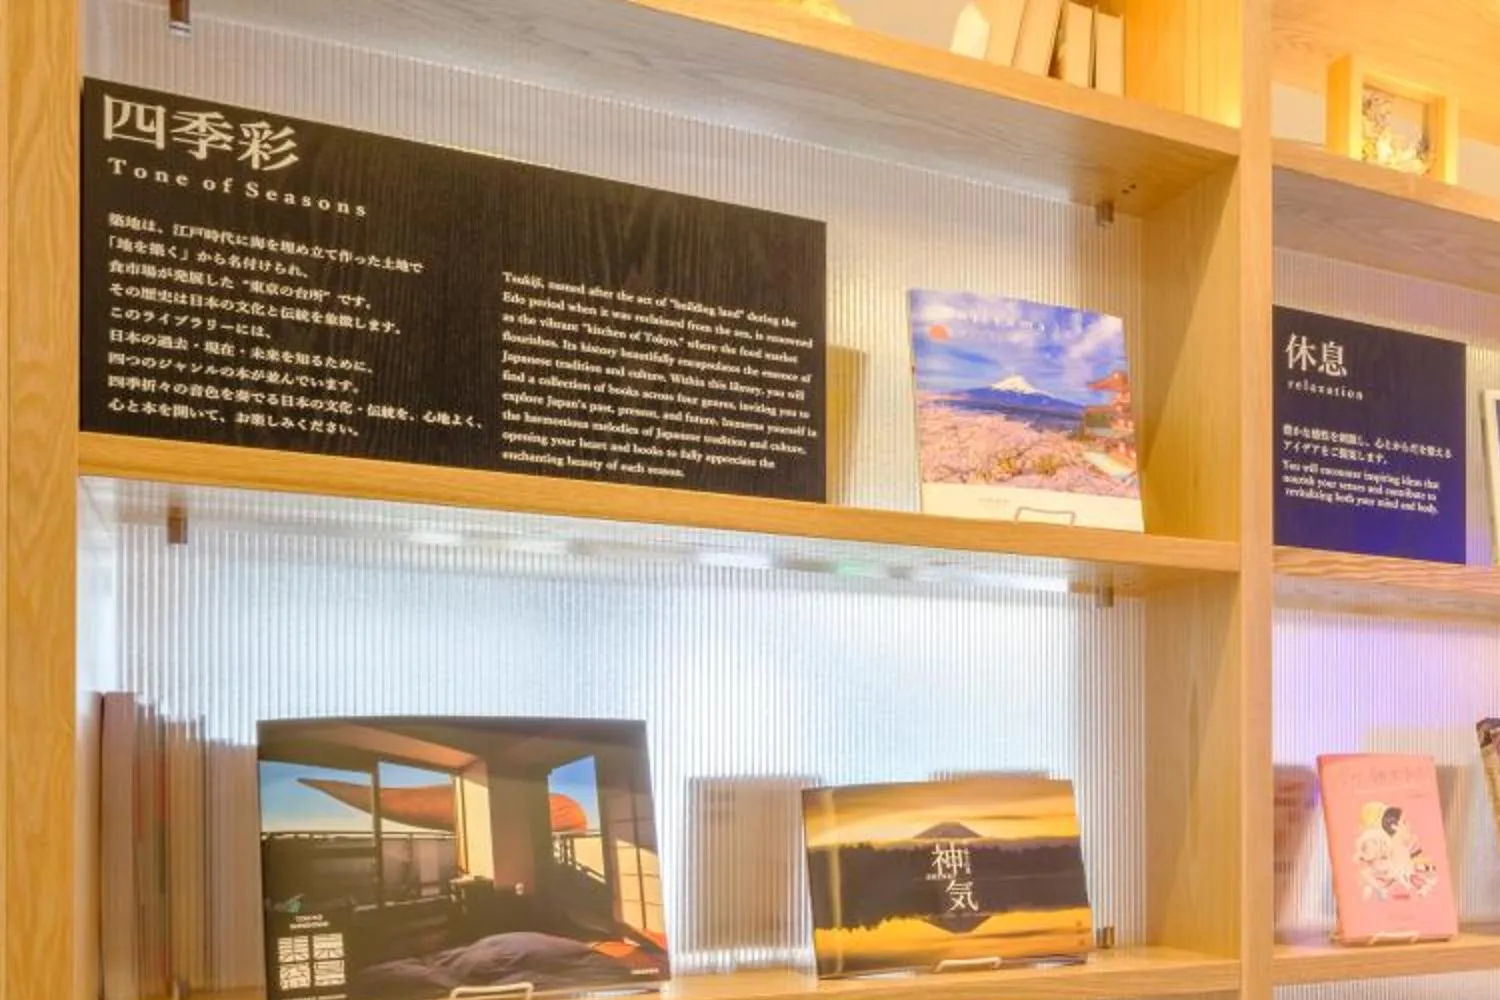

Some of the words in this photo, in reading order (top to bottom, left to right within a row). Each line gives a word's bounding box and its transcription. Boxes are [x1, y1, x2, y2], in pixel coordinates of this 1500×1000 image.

[103, 95, 299, 171] 四季彩
[107, 157, 189, 187] Tone
[203, 177, 233, 193] of
[245, 182, 366, 217] Seasons
[110, 307, 271, 339] このライブラリーには、
[502, 290, 526, 305] Edo
[527, 297, 565, 311] period
[566, 301, 597, 316] when
[599, 306, 609, 317] it
[610, 310, 632, 321] was
[634, 313, 685, 329] reclaimed
[686, 319, 712, 333] from
[714, 323, 732, 336] the
[754, 329, 764, 341] is
[547, 281, 586, 295] named
[587, 286, 614, 299] after
[615, 289, 634, 303] the
[636, 295, 653, 305] act
[654, 296, 668, 307] of
[746, 311, 779, 327] during
[780, 316, 797, 328] the
[501, 313, 515, 323] as
[516, 312, 537, 325] the
[538, 316, 579, 332] vibrant
[628, 329, 642, 341] of
[686, 338, 719, 353] where
[719, 343, 737, 355] the
[738, 345, 763, 359] food
[501, 329, 559, 348] flourishes.
[562, 338, 578, 351] Its
[579, 341, 618, 358] history
[742, 364, 760, 376] the
[799, 373, 812, 383] of
[1286, 333, 1347, 376] 休息
[107, 351, 359, 394] 四つのジャンルの本が並んでいます。
[501, 349, 552, 367] Japanese
[554, 358, 602, 374] tradition
[604, 365, 625, 377] and
[669, 372, 706, 387] Within
[707, 378, 727, 390] this
[766, 388, 785, 398] you
[786, 389, 805, 401] will
[501, 369, 525, 383] find
[527, 375, 536, 384] a
[537, 375, 591, 391] collection
[592, 382, 606, 393] of
[607, 383, 640, 397] books
[641, 390, 675, 401] across
[676, 392, 699, 405] four
[778, 407, 797, 417] you
[798, 410, 810, 419] to
[1288, 379, 1363, 400] relaxation
[501, 391, 544, 405] explore
[545, 394, 587, 410] Japan's
[661, 410, 683, 422] and
[806, 427, 817, 438] in
[501, 408, 521, 421] the
[523, 411, 589, 429] harmonious
[591, 421, 639, 435] melodies
[640, 425, 654, 437] of
[655, 426, 701, 442] Japanese
[703, 434, 747, 448] tradition
[748, 439, 768, 450] and
[501, 431, 549, 447] opening
[550, 436, 576, 447] your
[578, 436, 608, 451] heart
[609, 441, 631, 453] and
[632, 442, 664, 457] books
[665, 448, 678, 458] to
[679, 448, 703, 463] fully
[704, 454, 757, 467] appreciate
[758, 456, 775, 468] the
[501, 450, 565, 467] enchanting
[566, 454, 603, 471] beauty
[605, 459, 618, 471] of
[619, 461, 645, 473] each
[931, 842, 979, 911] 神気
